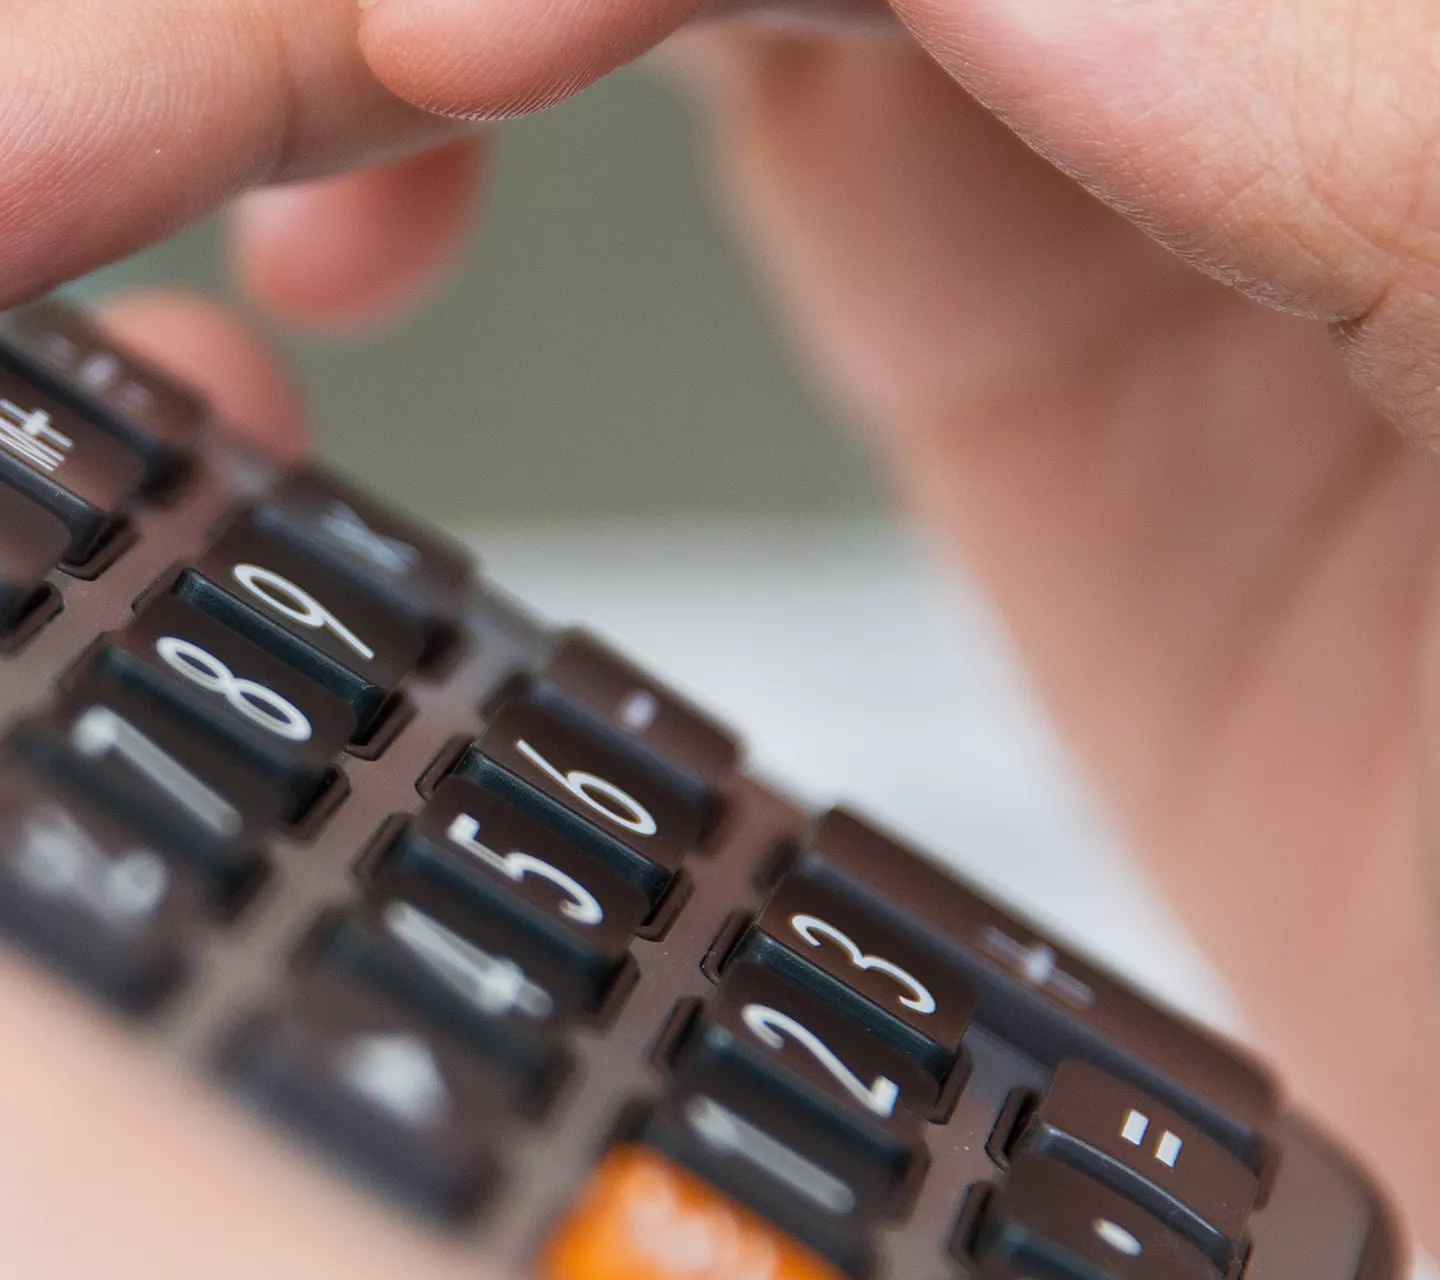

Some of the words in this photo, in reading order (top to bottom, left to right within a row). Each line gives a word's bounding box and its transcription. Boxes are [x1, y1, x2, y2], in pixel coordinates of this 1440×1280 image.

[234, 562, 376, 660] 9
[155, 636, 312, 742] 8
[70, 705, 242, 837] 7
[517, 738, 657, 836] 6
[447, 812, 603, 925] 5
[384, 899, 554, 1018] 4
[791, 914, 936, 1015] 3
[743, 1003, 899, 1117] 2
[684, 1093, 857, 1215] 1
